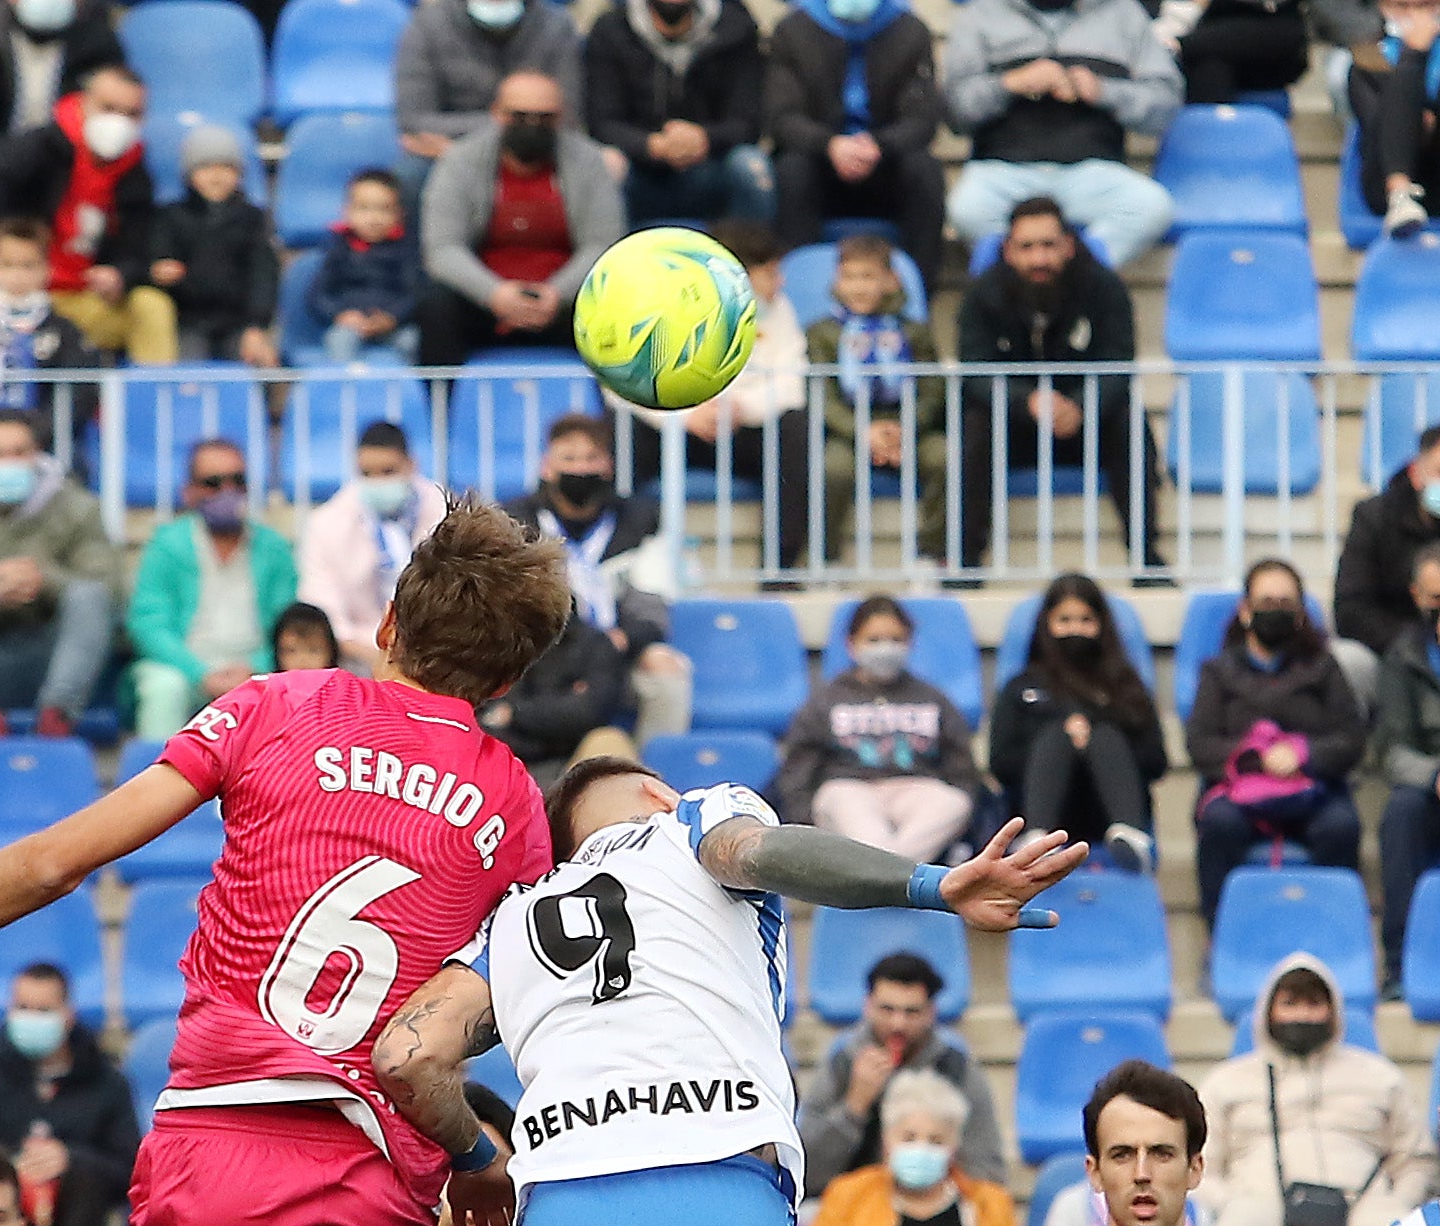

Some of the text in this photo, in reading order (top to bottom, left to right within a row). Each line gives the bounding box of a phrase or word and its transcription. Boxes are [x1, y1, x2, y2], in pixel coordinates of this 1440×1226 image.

[313, 745, 485, 828] SERGIO
[472, 814, 507, 871] G.
[259, 855, 422, 1055] 6
[527, 872, 636, 1005] 9
[522, 1079, 759, 1151] BENAHAVIS
